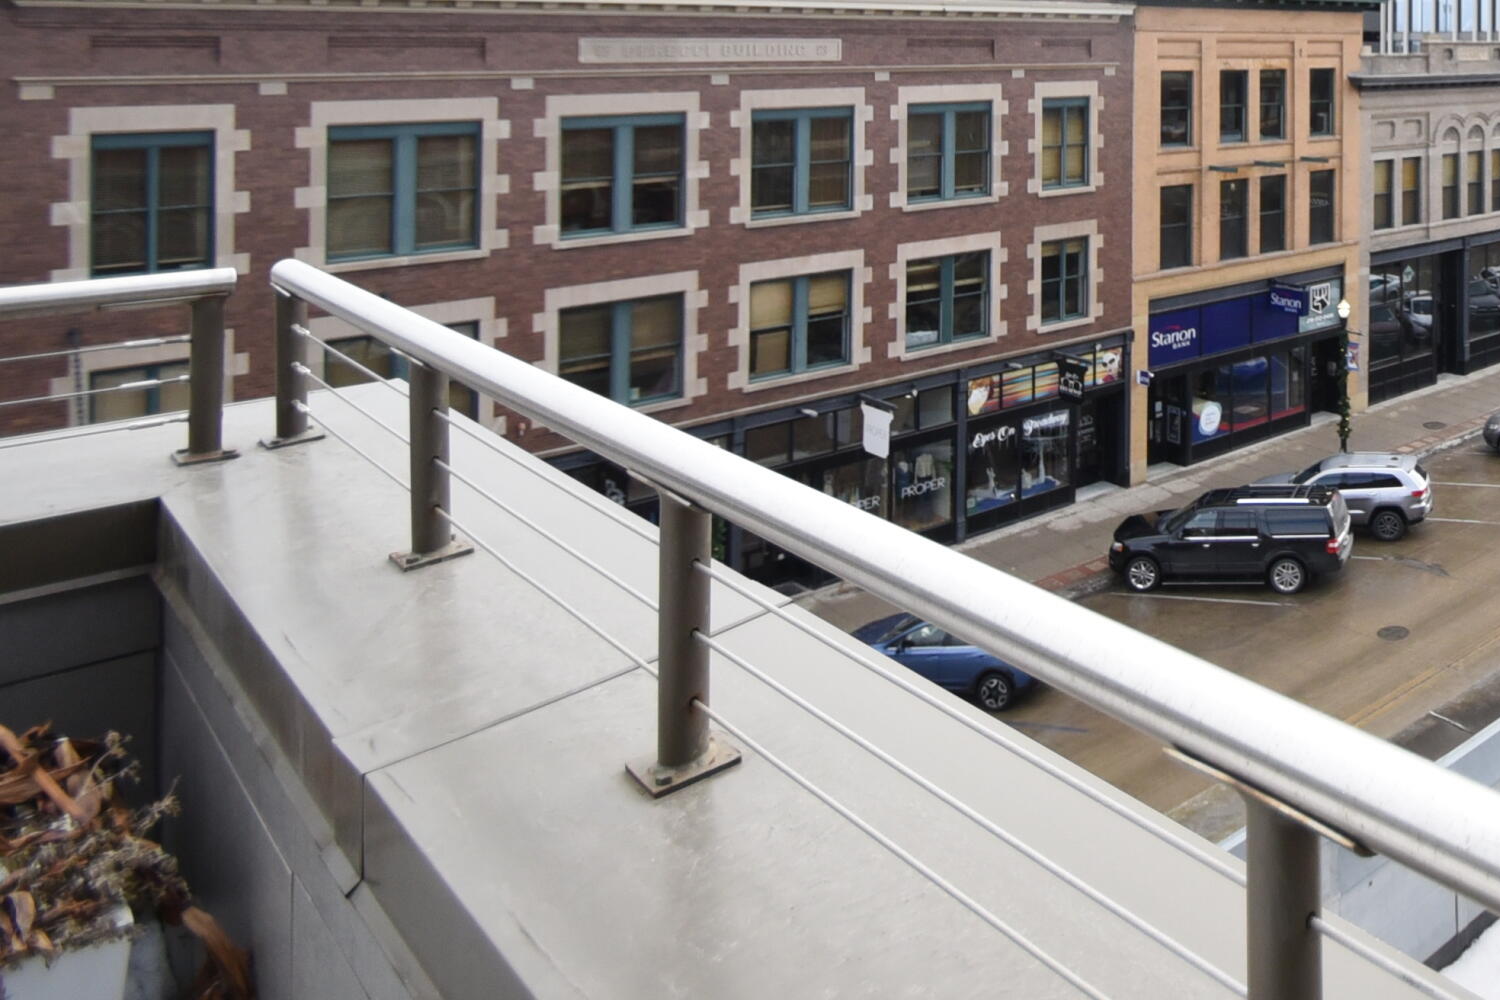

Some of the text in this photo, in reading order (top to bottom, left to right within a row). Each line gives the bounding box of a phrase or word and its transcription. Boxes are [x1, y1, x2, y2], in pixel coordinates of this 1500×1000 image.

[972, 432, 996, 449] Eyes
[997, 425, 1016, 442] On
[901, 476, 945, 499] PROPER
[852, 495, 881, 510] PER
